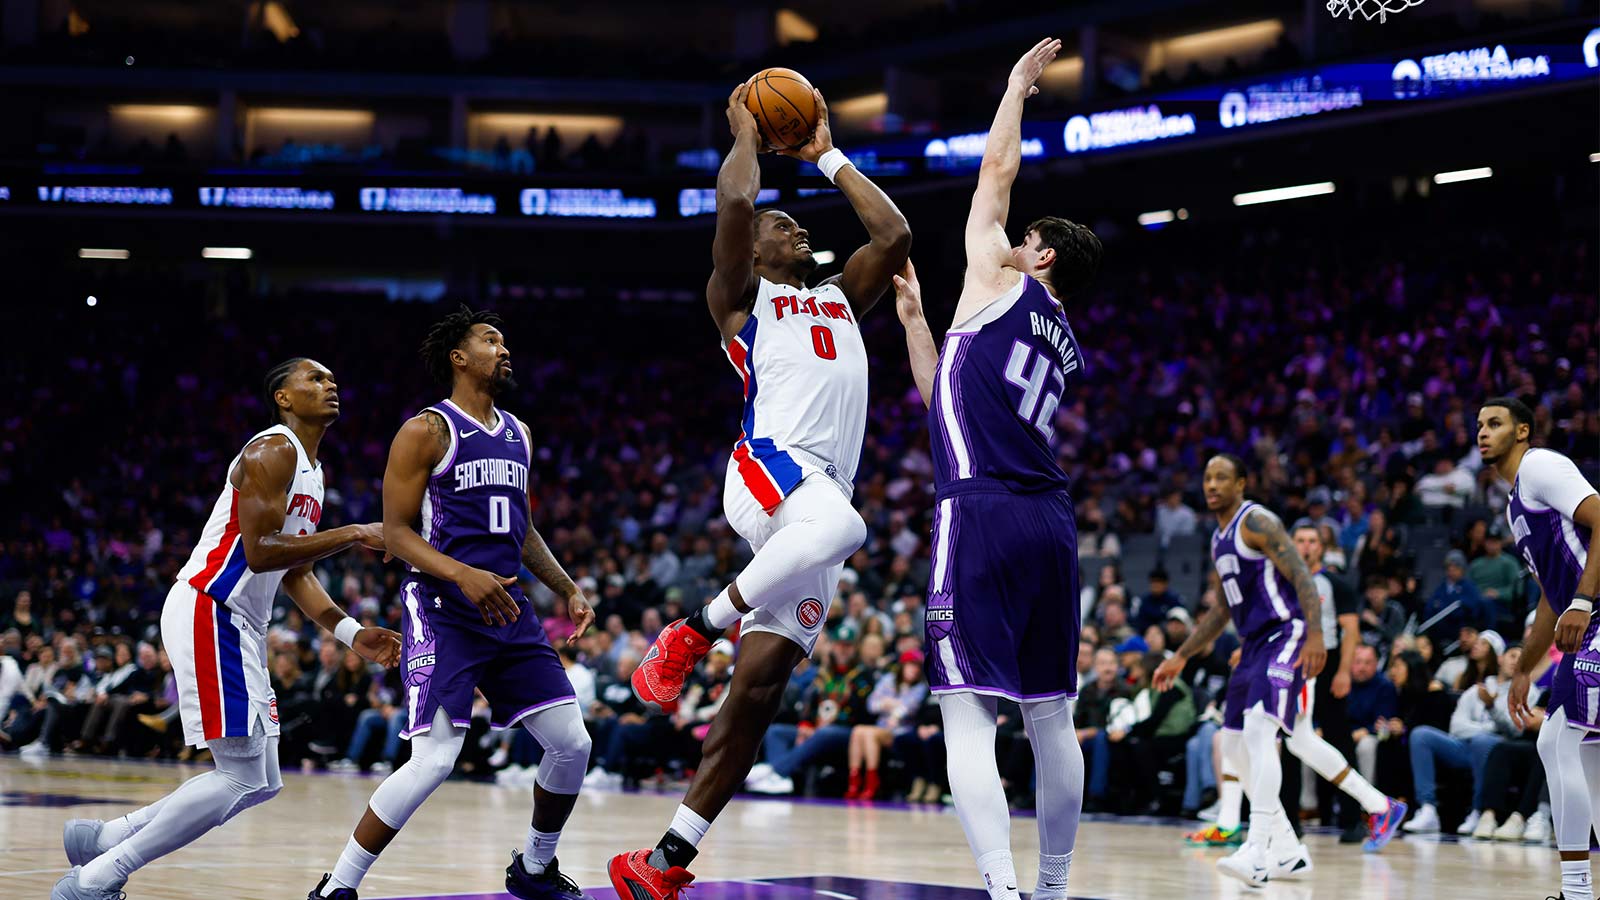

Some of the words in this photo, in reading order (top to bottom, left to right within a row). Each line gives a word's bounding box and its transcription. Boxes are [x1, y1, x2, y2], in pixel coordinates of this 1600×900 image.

[810, 325, 837, 361] 0
[1003, 338, 1065, 442] 42
[454, 458, 528, 495] SACRAMENT
[489, 496, 511, 534] 0
[926, 610, 954, 621] KINGS
[407, 655, 436, 672] KINGS
[1573, 660, 1600, 673] KING
